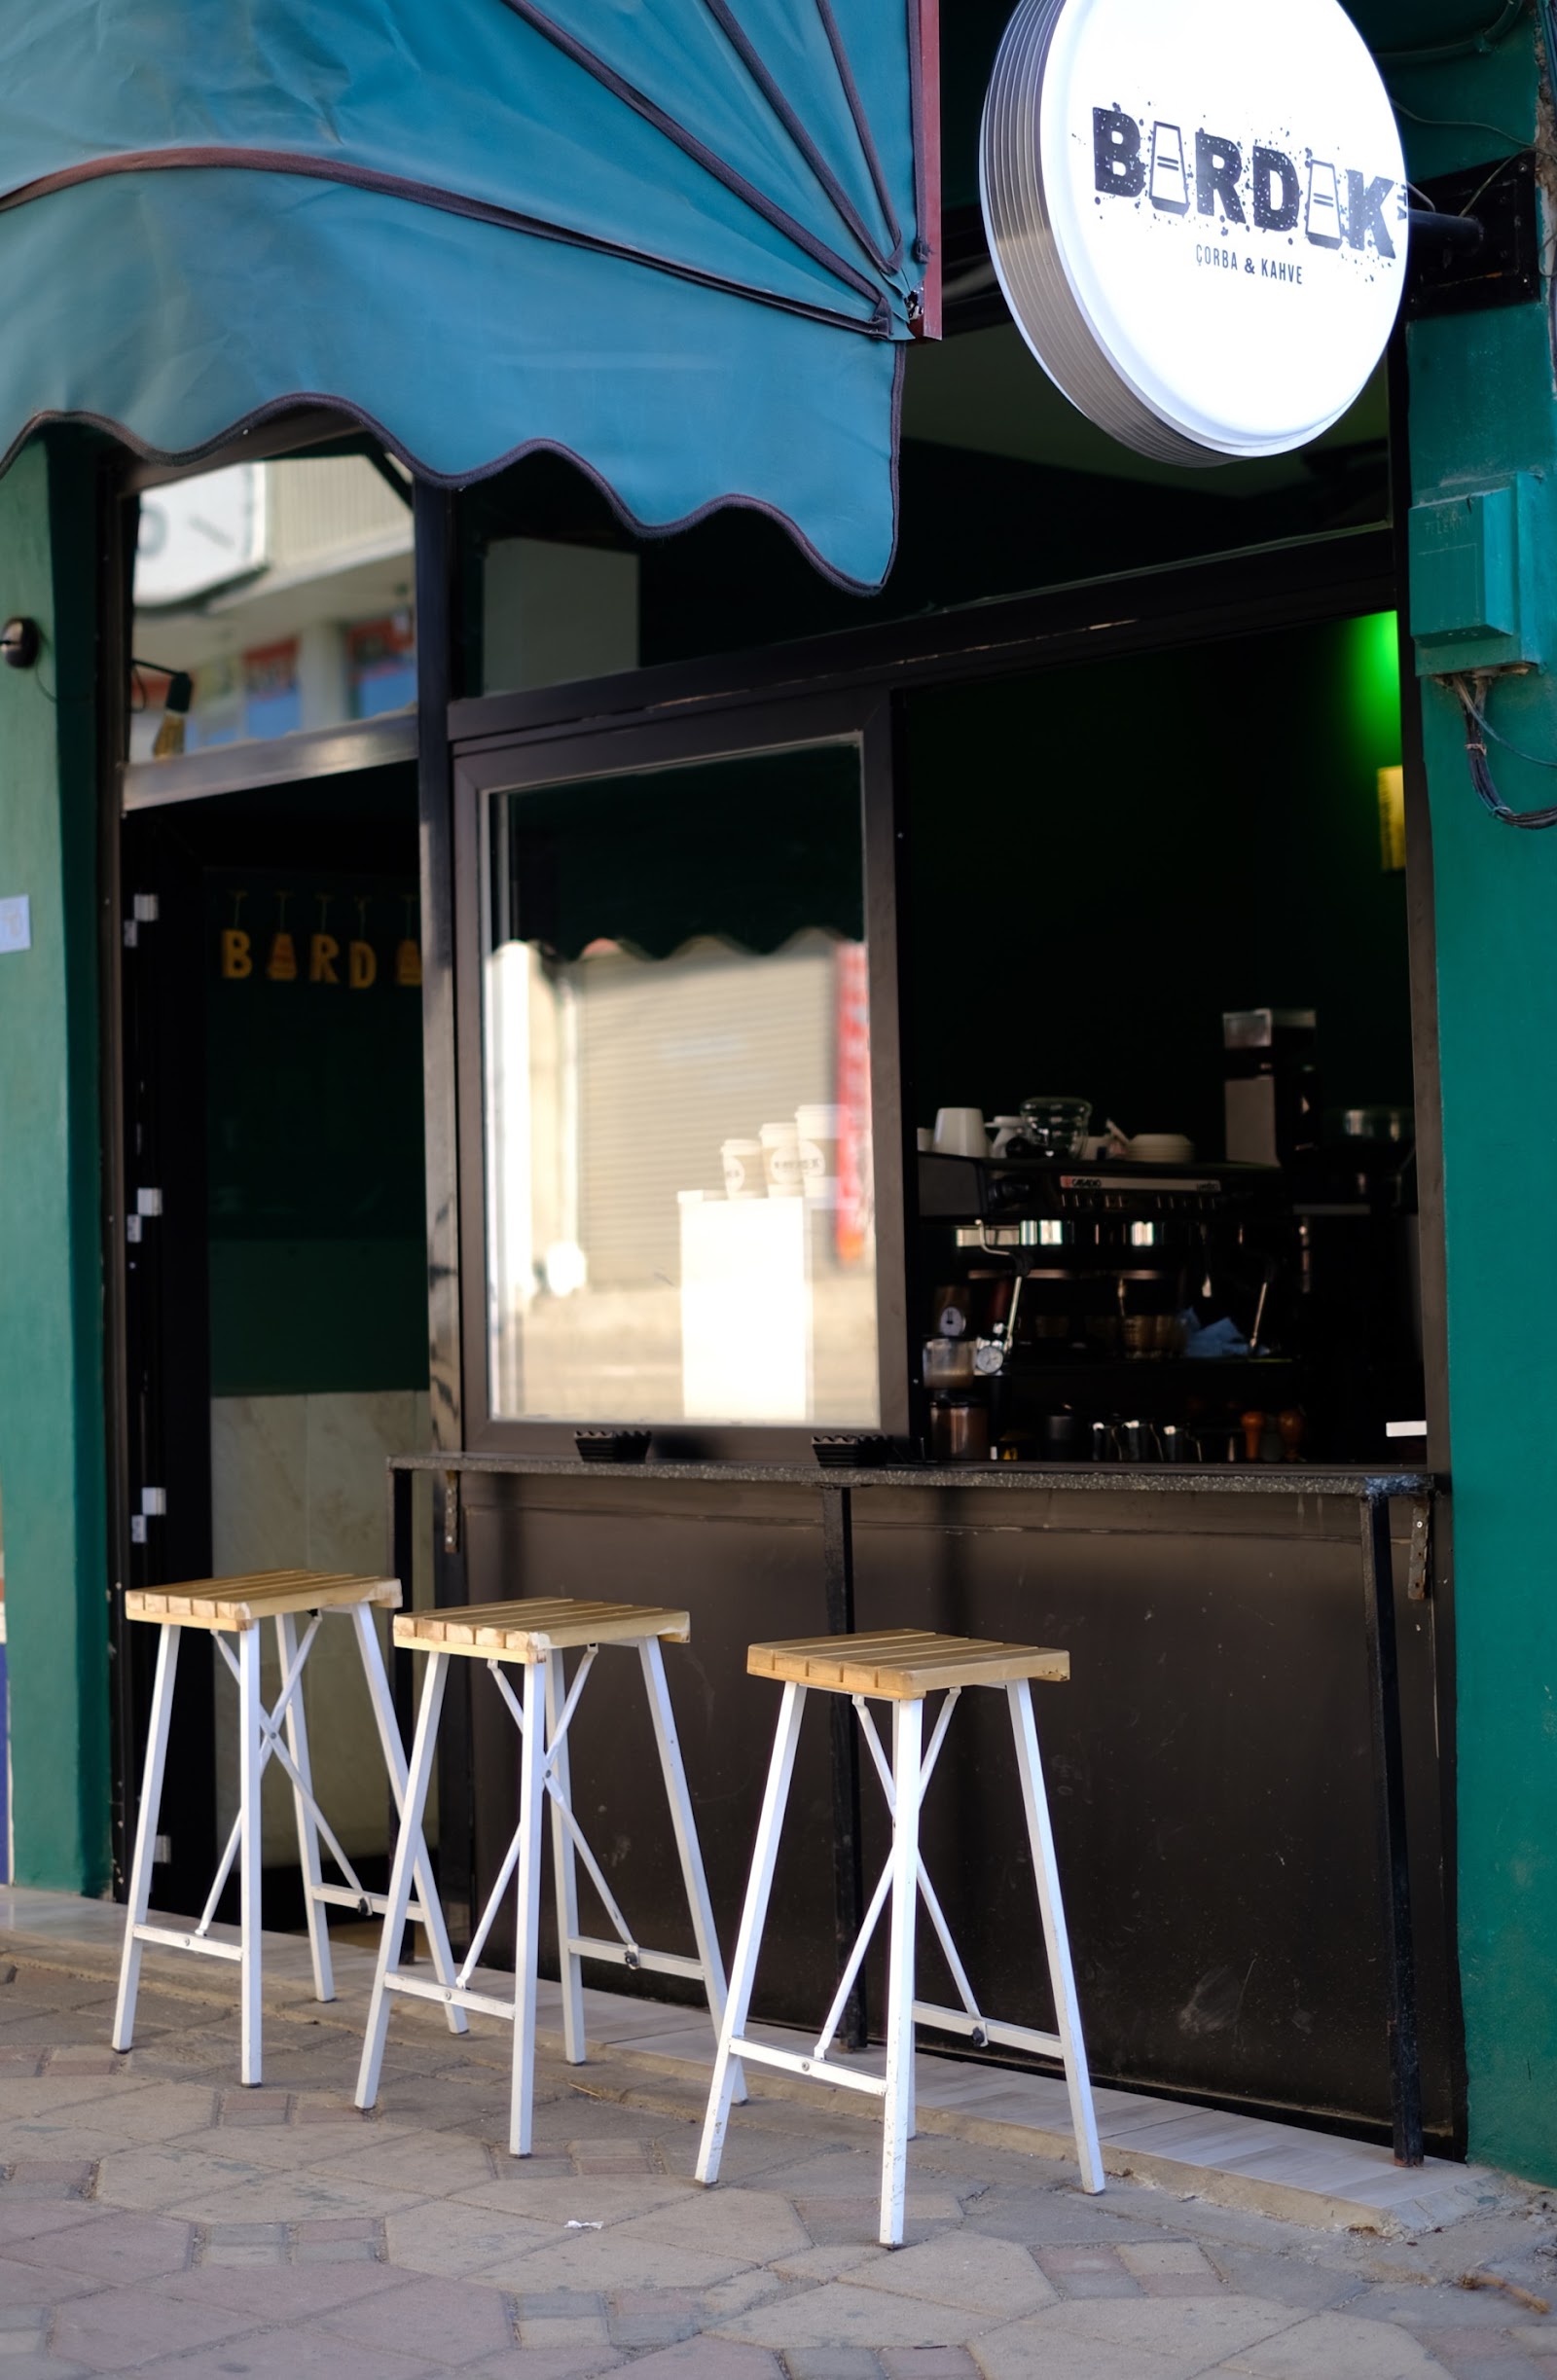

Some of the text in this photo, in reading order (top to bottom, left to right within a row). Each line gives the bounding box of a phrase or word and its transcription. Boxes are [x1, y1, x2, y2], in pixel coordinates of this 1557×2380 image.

[1196, 244, 1303, 284] ÇORBA & KAHVE
